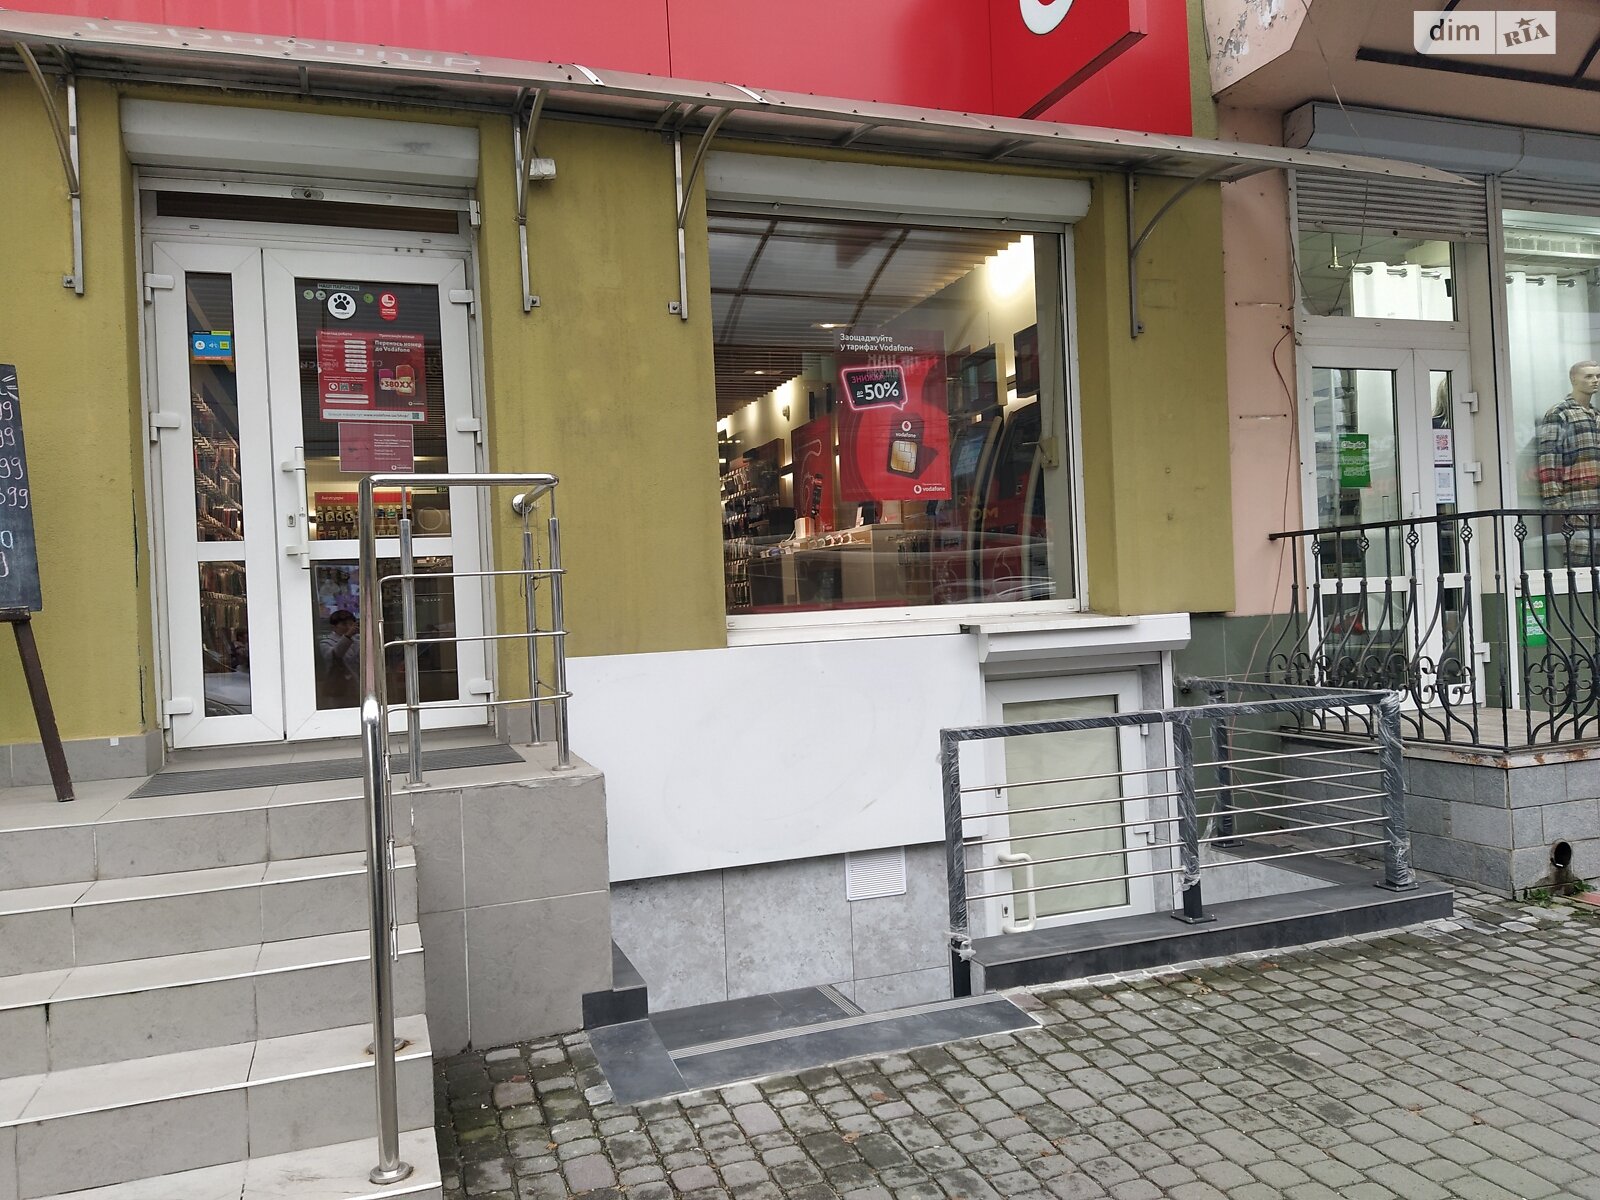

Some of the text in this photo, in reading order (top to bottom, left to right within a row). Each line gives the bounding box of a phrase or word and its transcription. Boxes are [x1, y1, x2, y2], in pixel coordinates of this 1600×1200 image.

[840, 333, 893, 343] Заощаджуйте
[846, 344, 879, 352] тарифах
[880, 344, 914, 352] Vodafone
[381, 380, 413, 389] +380XX
[864, 381, 899, 400] 50%
